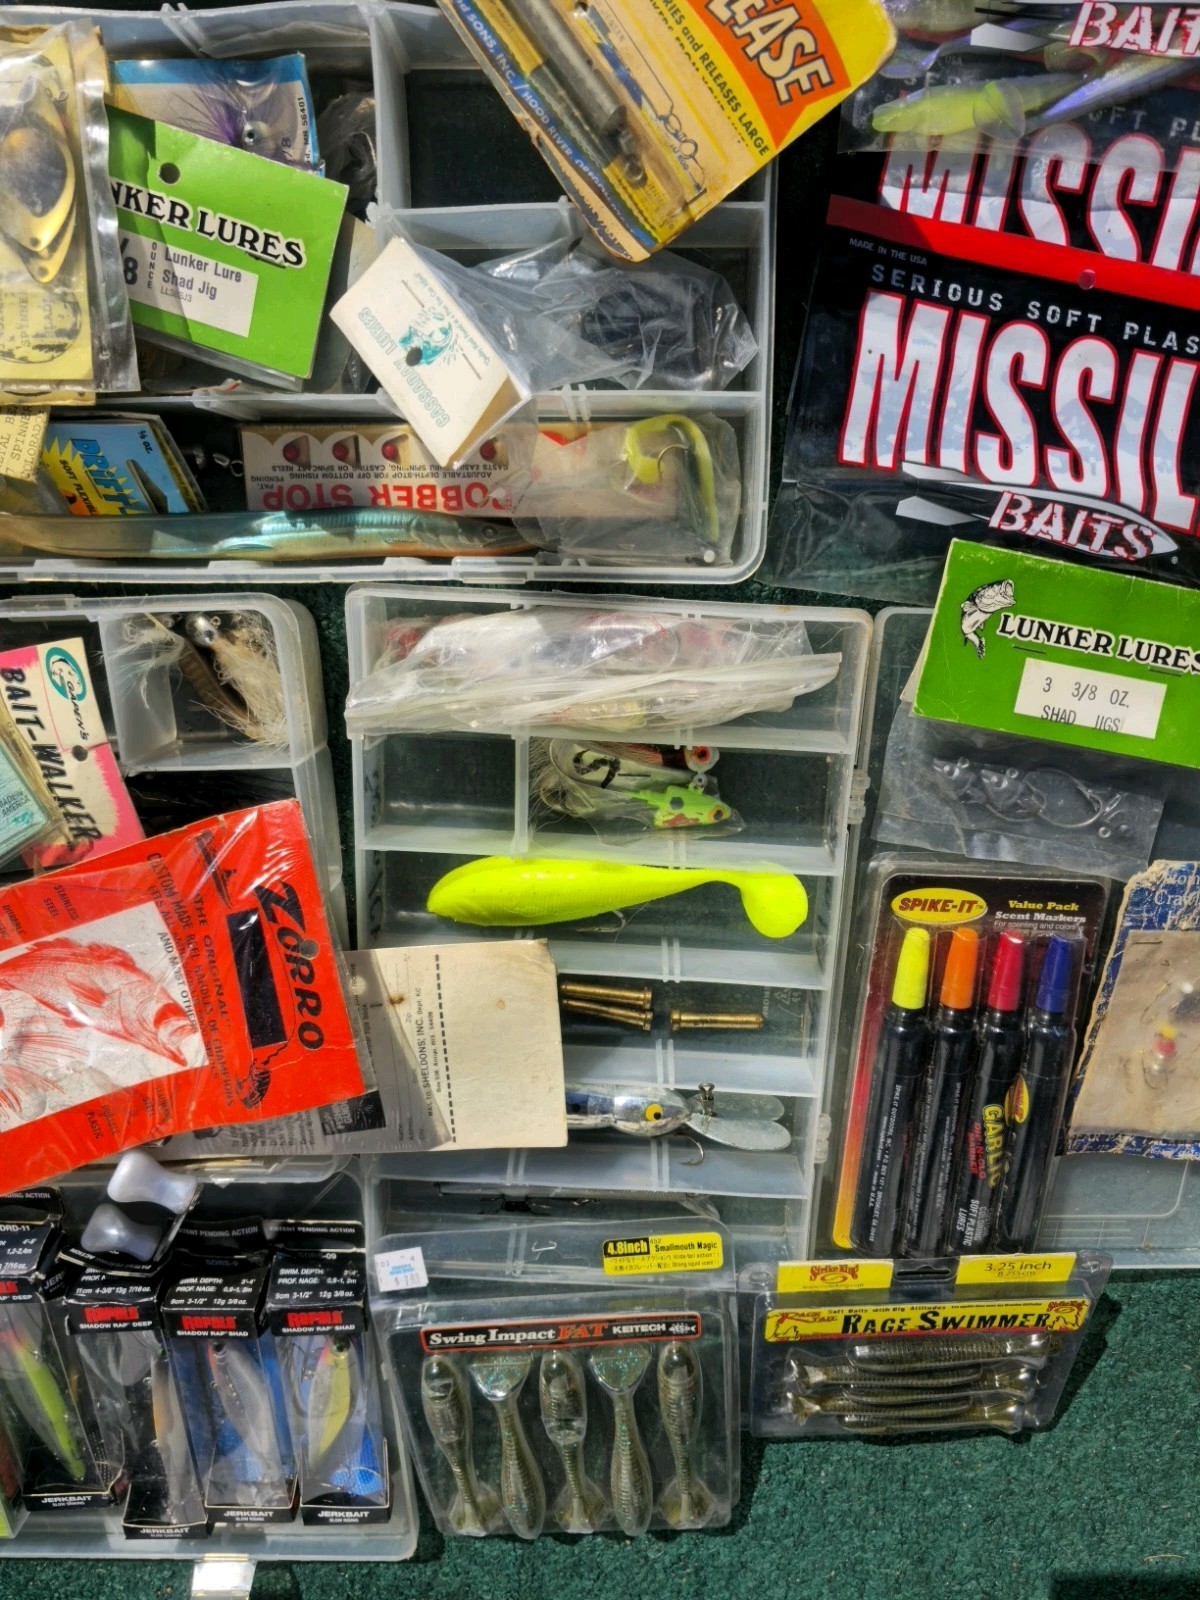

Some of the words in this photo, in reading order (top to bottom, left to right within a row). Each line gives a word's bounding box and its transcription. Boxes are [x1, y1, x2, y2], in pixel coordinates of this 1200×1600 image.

[467, 11, 497, 53] SONS,
[495, 52, 514, 84] INC.
[521, 91, 550, 125] HOOD
[681, 26, 703, 51] and
[699, 51, 741, 112] RELEASES
[737, 111, 770, 156] LARGE
[878, 121, 1200, 276] MISSI
[197, 209, 305, 267] LURES
[849, 238, 877, 250] MADE
[878, 244, 889, 254] IN
[890, 248, 908, 260] THE
[909, 253, 928, 266] USA
[147, 242, 157, 290] OUNCE
[165, 247, 209, 273] Lunker
[214, 262, 242, 283] Lure
[162, 269, 194, 290] Shad
[198, 285, 218, 301] Jig
[871, 263, 1004, 312] SERIOUS
[1026, 300, 1102, 333] SOFT
[357, 306, 398, 356] LURES
[393, 357, 451, 429] CASSADAY
[60, 458, 78, 485] SOFT
[289, 472, 319, 480] FISHING
[321, 472, 354, 480] BOTTOM
[374, 471, 389, 479] FOR
[391, 471, 440, 479] DEPTH-STOP
[442, 471, 493, 479] ADJUSTABLE
[256, 482, 275, 490] PAT.
[262, 481, 354, 512] STOP
[987, 490, 1155, 561] BAITS
[999, 613, 1113, 656] LUNKER
[1042, 676, 1053, 694] 3
[1070, 681, 1098, 702] 3/8
[1109, 690, 1130, 708] OZ.
[1040, 705, 1077, 726] SHAD
[0, 667, 102, 840] BAIT-WALKER
[899, 897, 978, 914] SPIKE-IT
[995, 911, 1031, 921] Scent
[1033, 912, 1086, 924] Markers
[1008, 900, 1043, 910] Value
[1047, 902, 1079, 911] Pack
[1039, 922, 1053, 930] and
[146, 852, 177, 898] CUSTOM
[171, 898, 194, 931] MADE
[207, 1015, 219, 1034] OF
[157, 930, 174, 954] AND
[169, 954, 184, 988] MOST
[254, 880, 325, 1051] ZORRO
[416, 1017, 425, 1037] INC.
[982, 1103, 1004, 1189] GARLIC
[955, 1208, 967, 1232] LURES
[970, 1199, 980, 1217] SOFT
[200, 1229, 228, 1237] PENDING
[231, 1226, 258, 1236] ACTION
[962, 1218, 977, 1247] PLASTIC
[69, 1247, 96, 1260] ACTION
[607, 1240, 648, 1255] 4.8inch
[655, 1243, 695, 1252] Smallmouth
[697, 1242, 717, 1251] Magic
[984, 1262, 1015, 1272] 3.25
[1019, 1261, 1052, 1270] inch
[292, 1291, 313, 1299] 3-1/2"
[841, 1313, 912, 1334] RAGE
[917, 1310, 1050, 1332] SWIMMER
[429, 1332, 486, 1347] Swing
[488, 1328, 556, 1344] Impact
[557, 1323, 608, 1340] FAT
[612, 1323, 667, 1334] KEITECH
[41, 1495, 92, 1504] JERKBAIT
[224, 1510, 274, 1518] JERKBAIT
[318, 1510, 370, 1518] JERKBAIT
[140, 1526, 190, 1535] JERKBAIT
